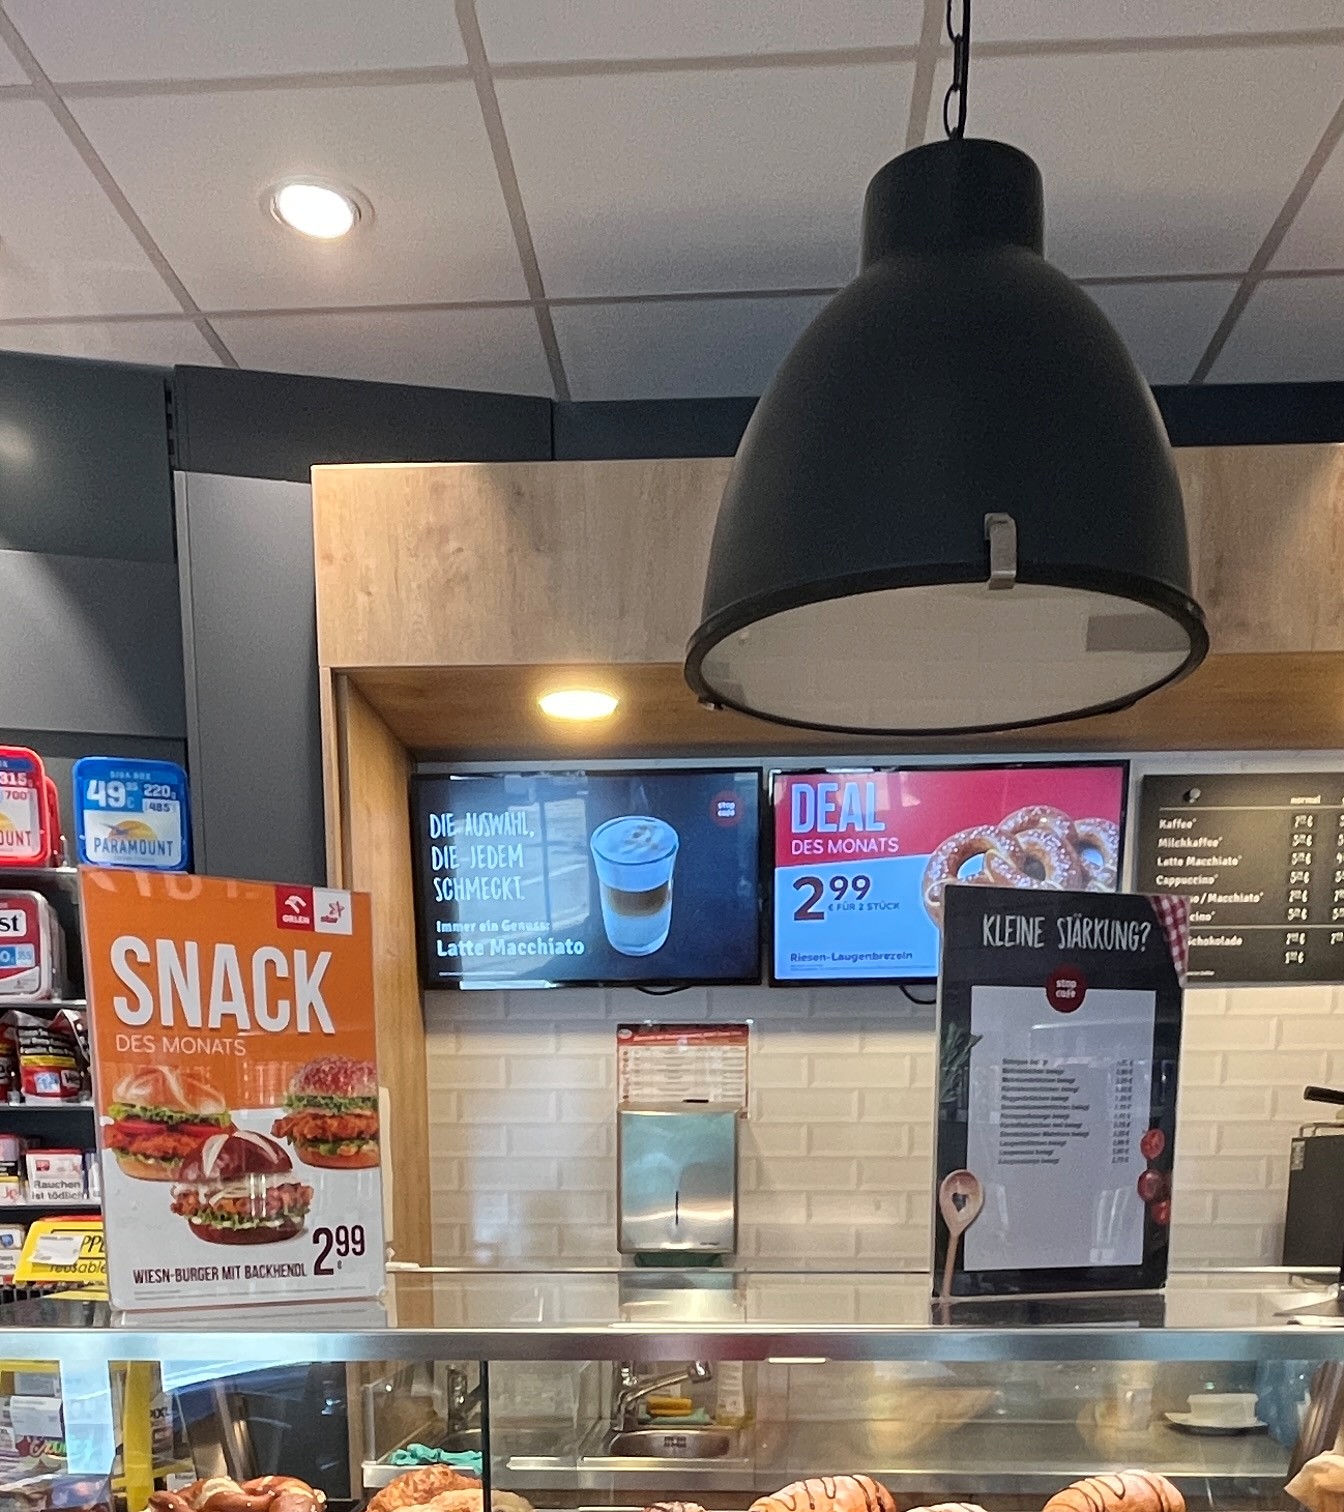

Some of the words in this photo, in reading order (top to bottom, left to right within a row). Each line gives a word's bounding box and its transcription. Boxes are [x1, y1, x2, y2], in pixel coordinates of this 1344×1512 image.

[791, 780, 887, 834] DEAL
[429, 813, 455, 839] DIE
[464, 811, 536, 838] AUSWAHL,
[93, 837, 174, 857] PARAMOUNT
[791, 839, 823, 855] DES
[828, 837, 899, 854] MONATS
[431, 844, 460, 871] DIE
[469, 844, 524, 869] JEDEM
[435, 876, 525, 903] SCHMECKT.
[436, 919, 476, 933] Immer
[479, 919, 499, 932] ein
[982, 913, 1045, 949] KLEINE
[1056, 912, 1151, 953] STÄRKUNG?
[437, 939, 484, 957] Latte
[490, 936, 585, 956] Macchiato
[790, 950, 913, 963] Riesen-Laugenbrezeln
[109, 935, 336, 1035] SNACK
[115, 1035, 156, 1054] DES
[162, 1036, 247, 1057] MONATS
[31, 1191, 44, 1200] ist
[34, 1180, 81, 1190] Rauchen
[132, 1266, 220, 1285] WIESN-BURGER
[222, 1265, 242, 1281] MIT
[244, 1261, 307, 1281] BACKHENDL
